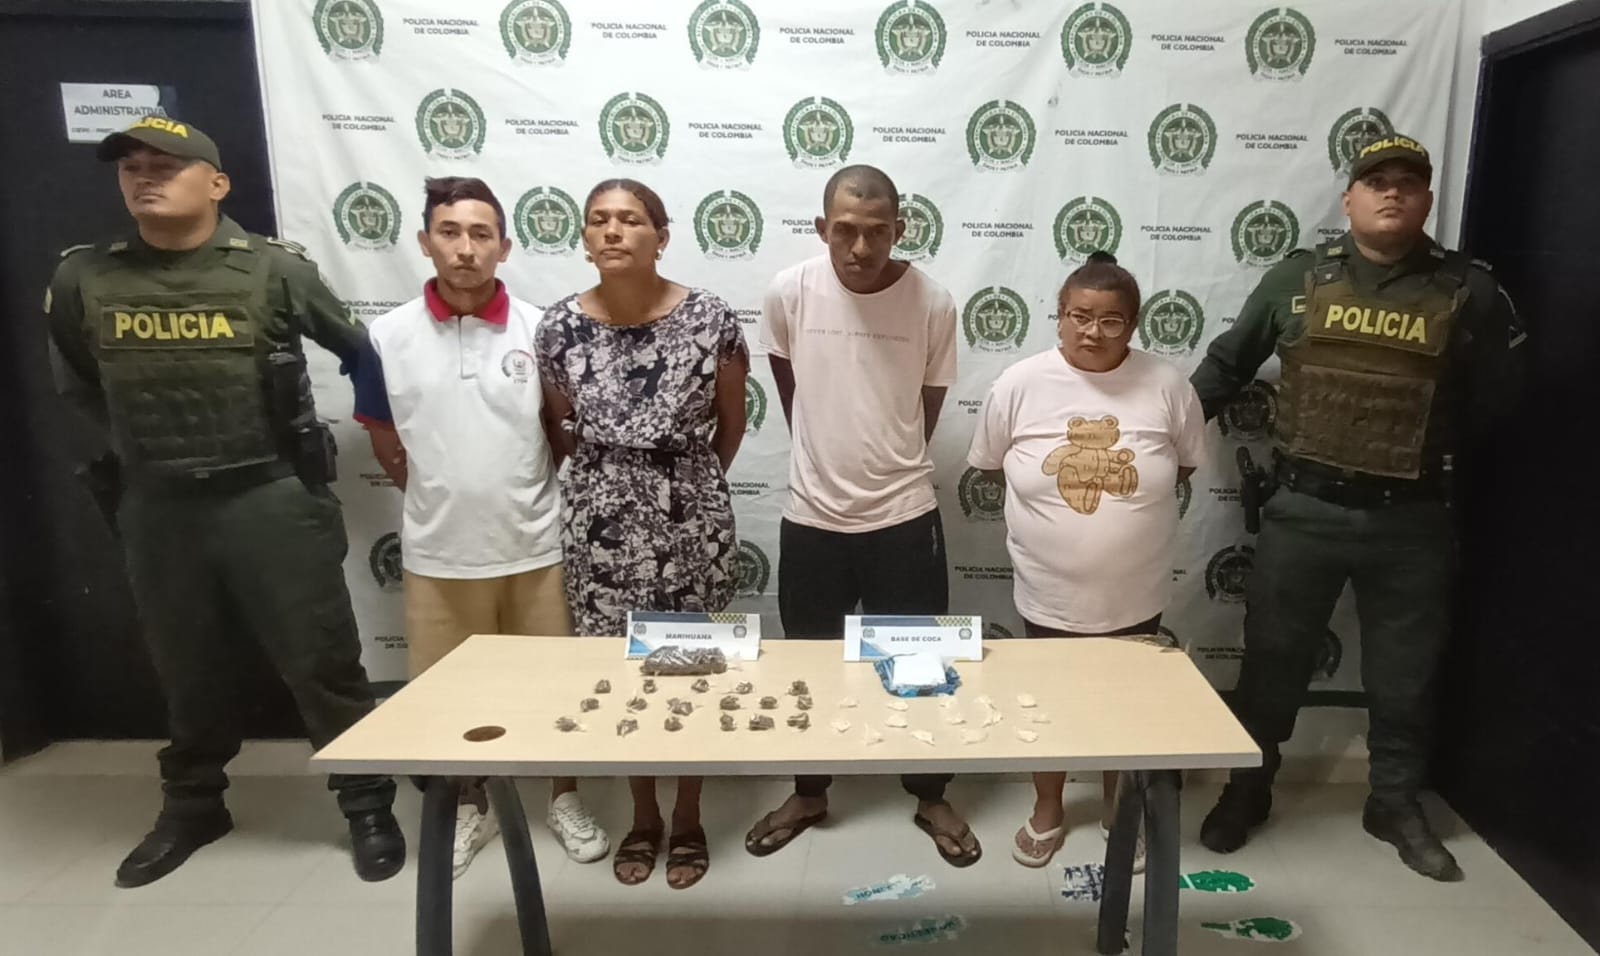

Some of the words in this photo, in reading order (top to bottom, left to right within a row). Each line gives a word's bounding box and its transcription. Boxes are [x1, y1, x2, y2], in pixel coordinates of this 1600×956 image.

[102, 90, 132, 98] AREA
[74, 105, 166, 116] ADMINISTRATIVA
[1360, 136, 1426, 158] POLICIA
[115, 312, 234, 340] POLICIA
[1325, 304, 1426, 344] POLICIA
